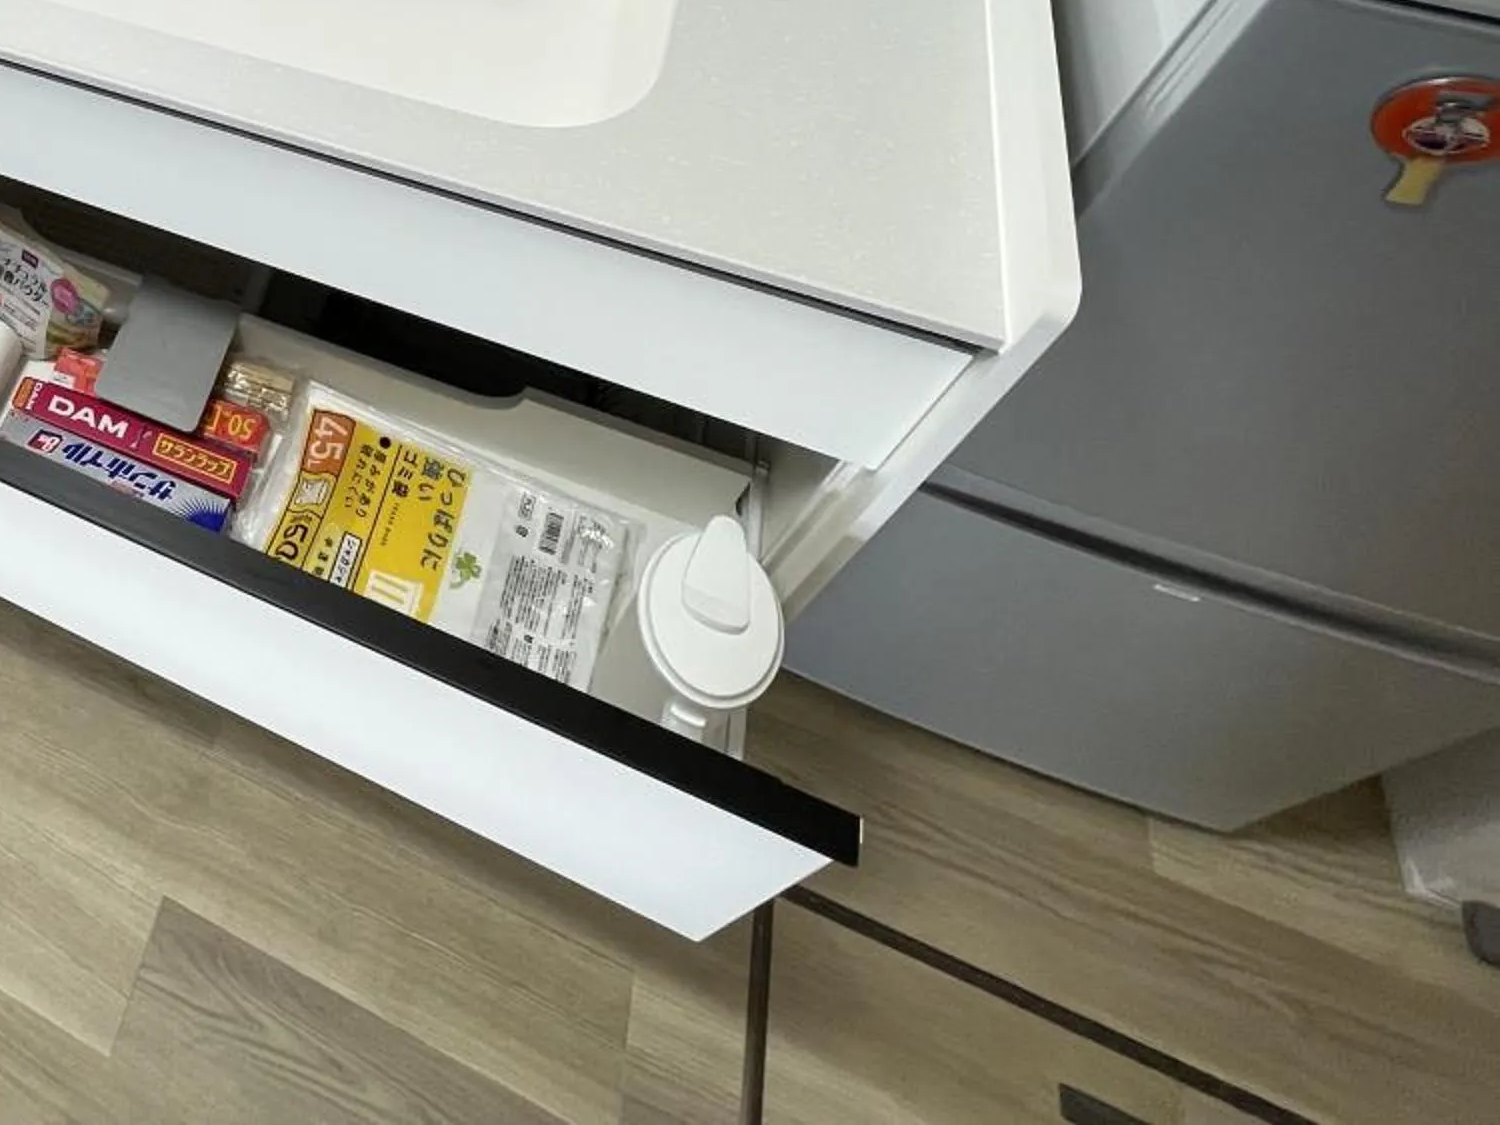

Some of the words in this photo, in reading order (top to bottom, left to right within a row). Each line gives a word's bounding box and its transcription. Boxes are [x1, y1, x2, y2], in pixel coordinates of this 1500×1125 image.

[48, 395, 129, 439] DAM
[61, 441, 177, 501] サンホイル
[420, 466, 466, 571] ひっぱりに
